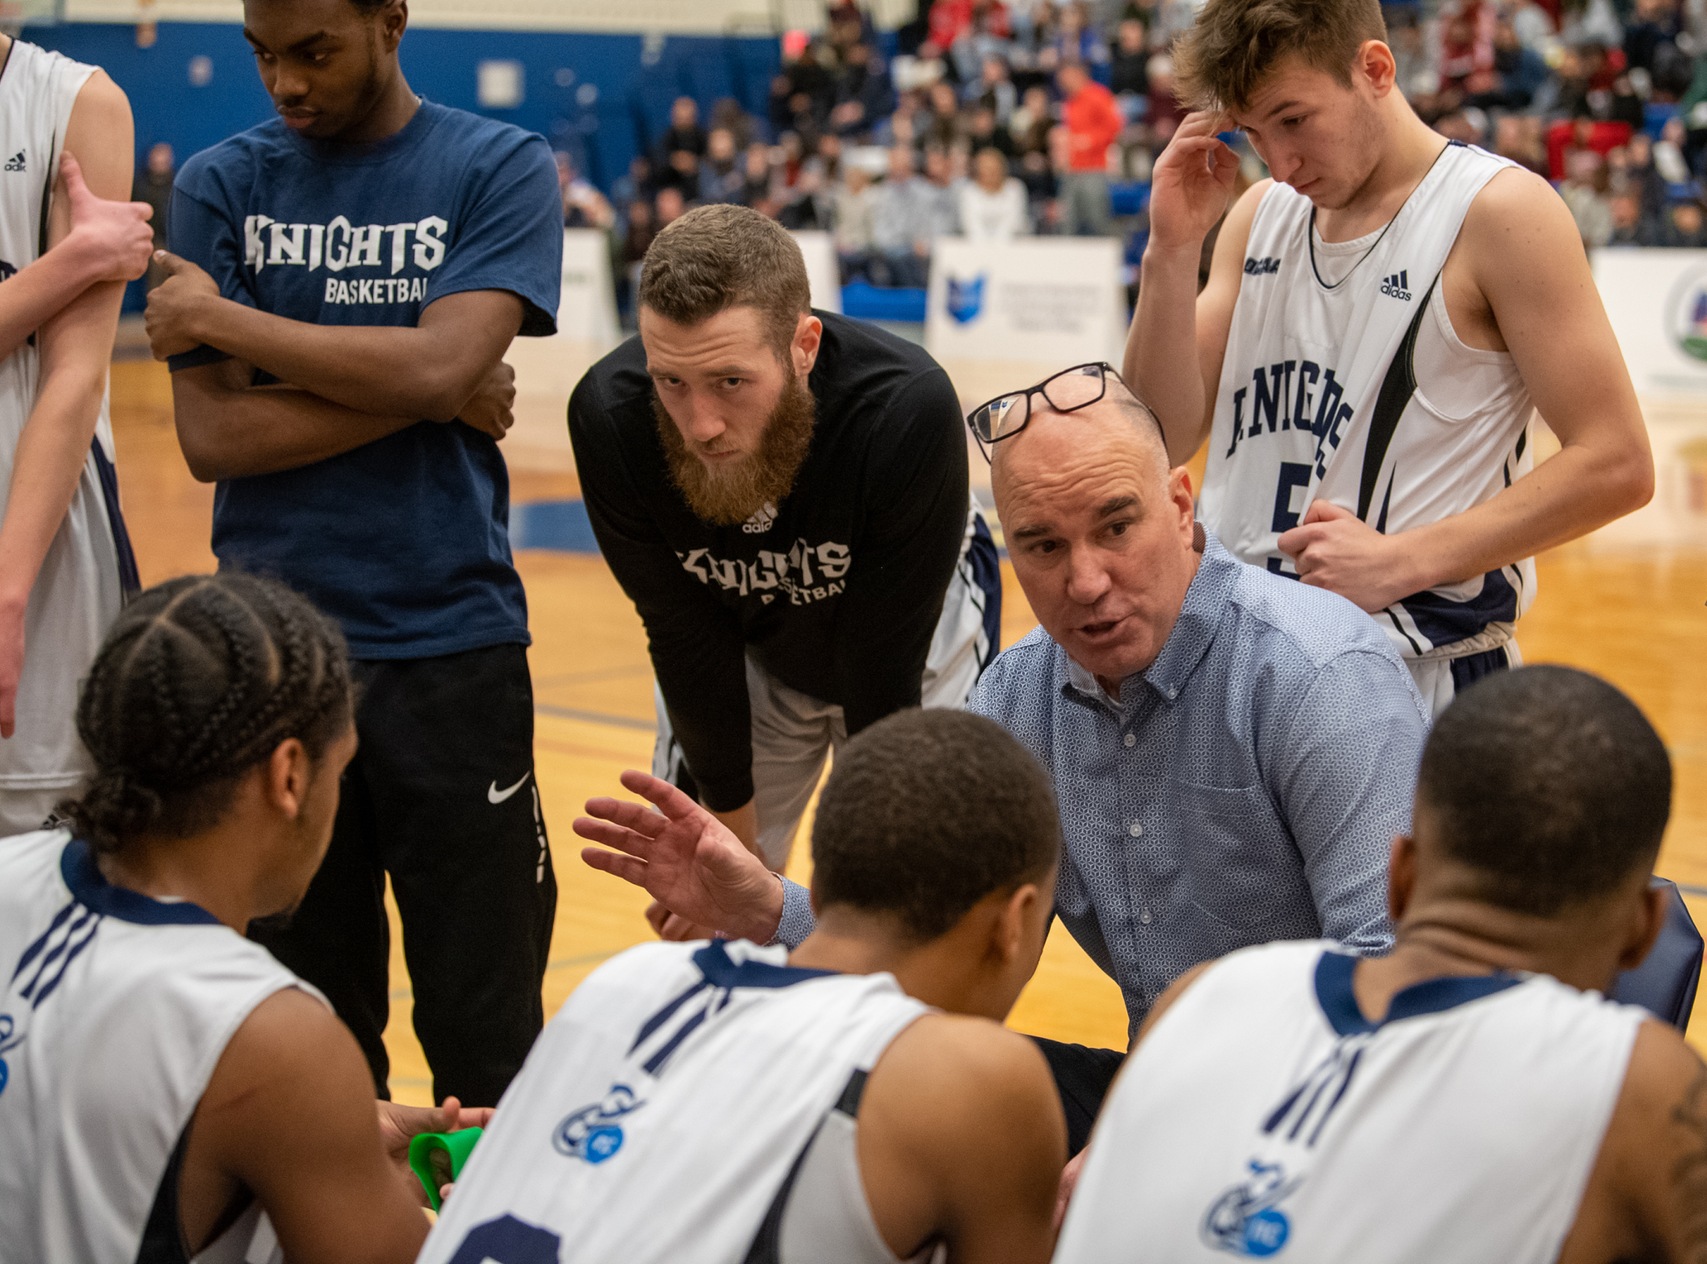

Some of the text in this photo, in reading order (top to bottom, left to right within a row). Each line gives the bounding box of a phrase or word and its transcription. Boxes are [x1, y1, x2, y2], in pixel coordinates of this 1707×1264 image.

[244, 214, 449, 276] KNIGHTS
[324, 277, 428, 305] BASKETBA
[742, 518, 773, 534] adid
